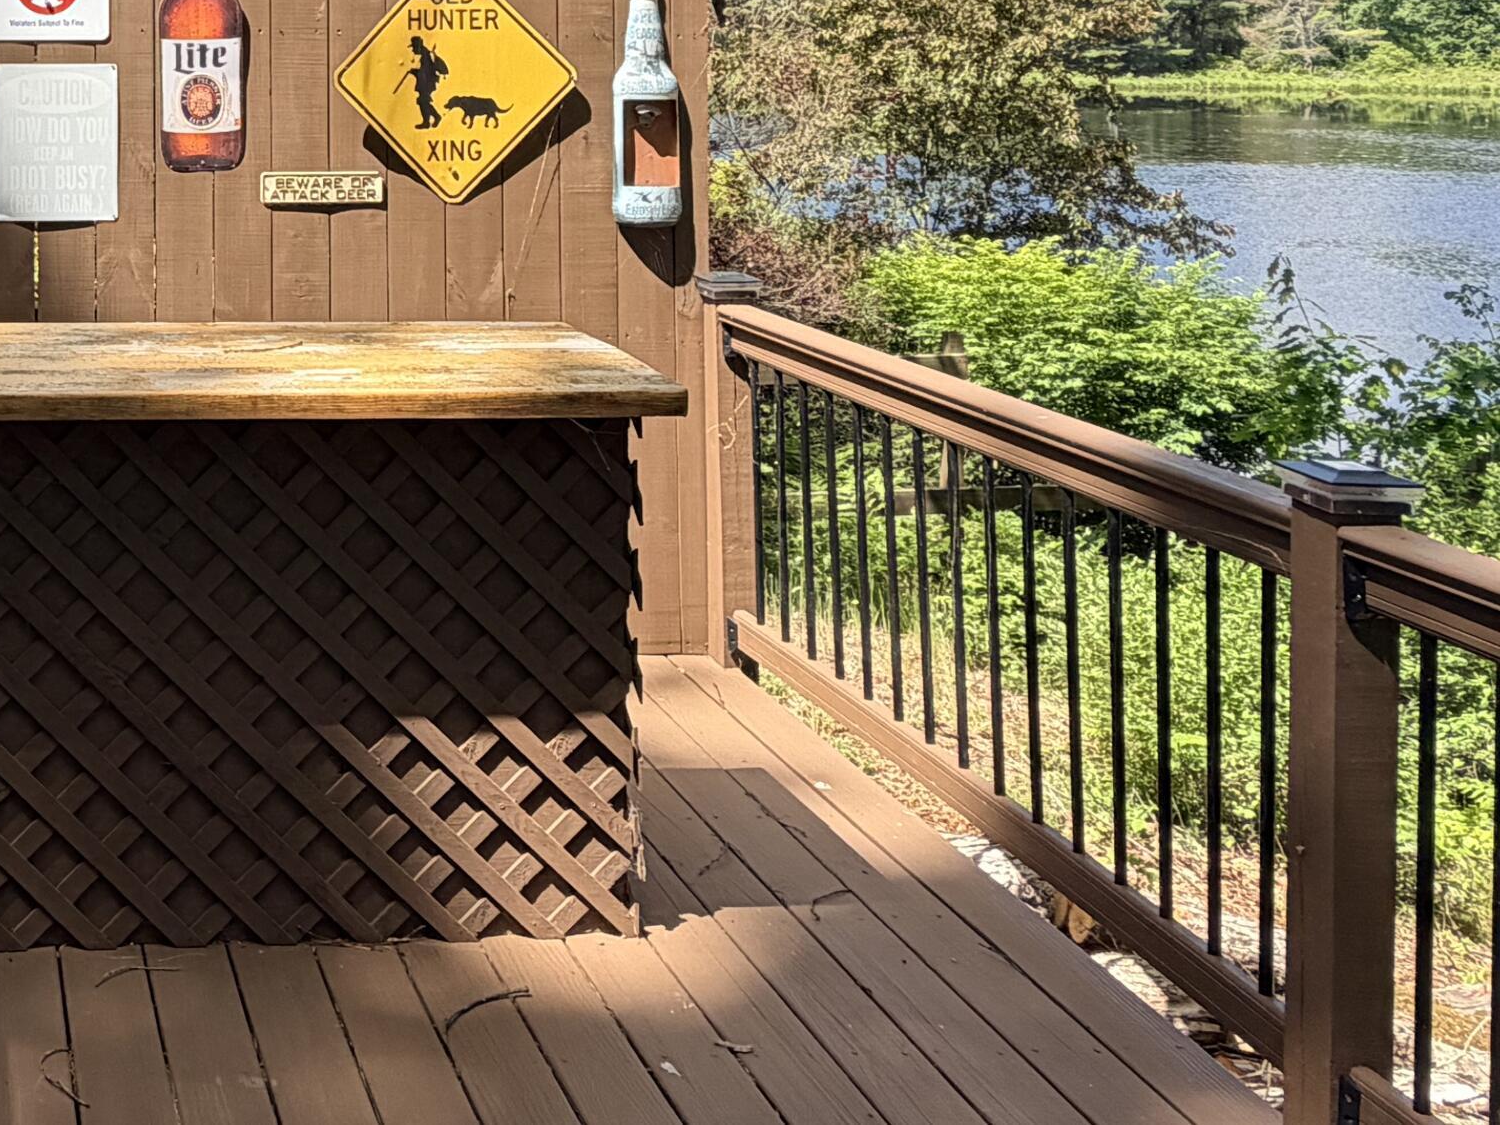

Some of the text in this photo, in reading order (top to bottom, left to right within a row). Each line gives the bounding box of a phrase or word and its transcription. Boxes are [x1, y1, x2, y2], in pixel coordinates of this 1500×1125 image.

[408, 9, 499, 30] HUNTER
[172, 43, 227, 74] Lite
[427, 139, 482, 161] XING
[3, 164, 49, 190] DIOT
[275, 177, 375, 189] BEWARE OF
[270, 189, 376, 201] ATTACK DEER
